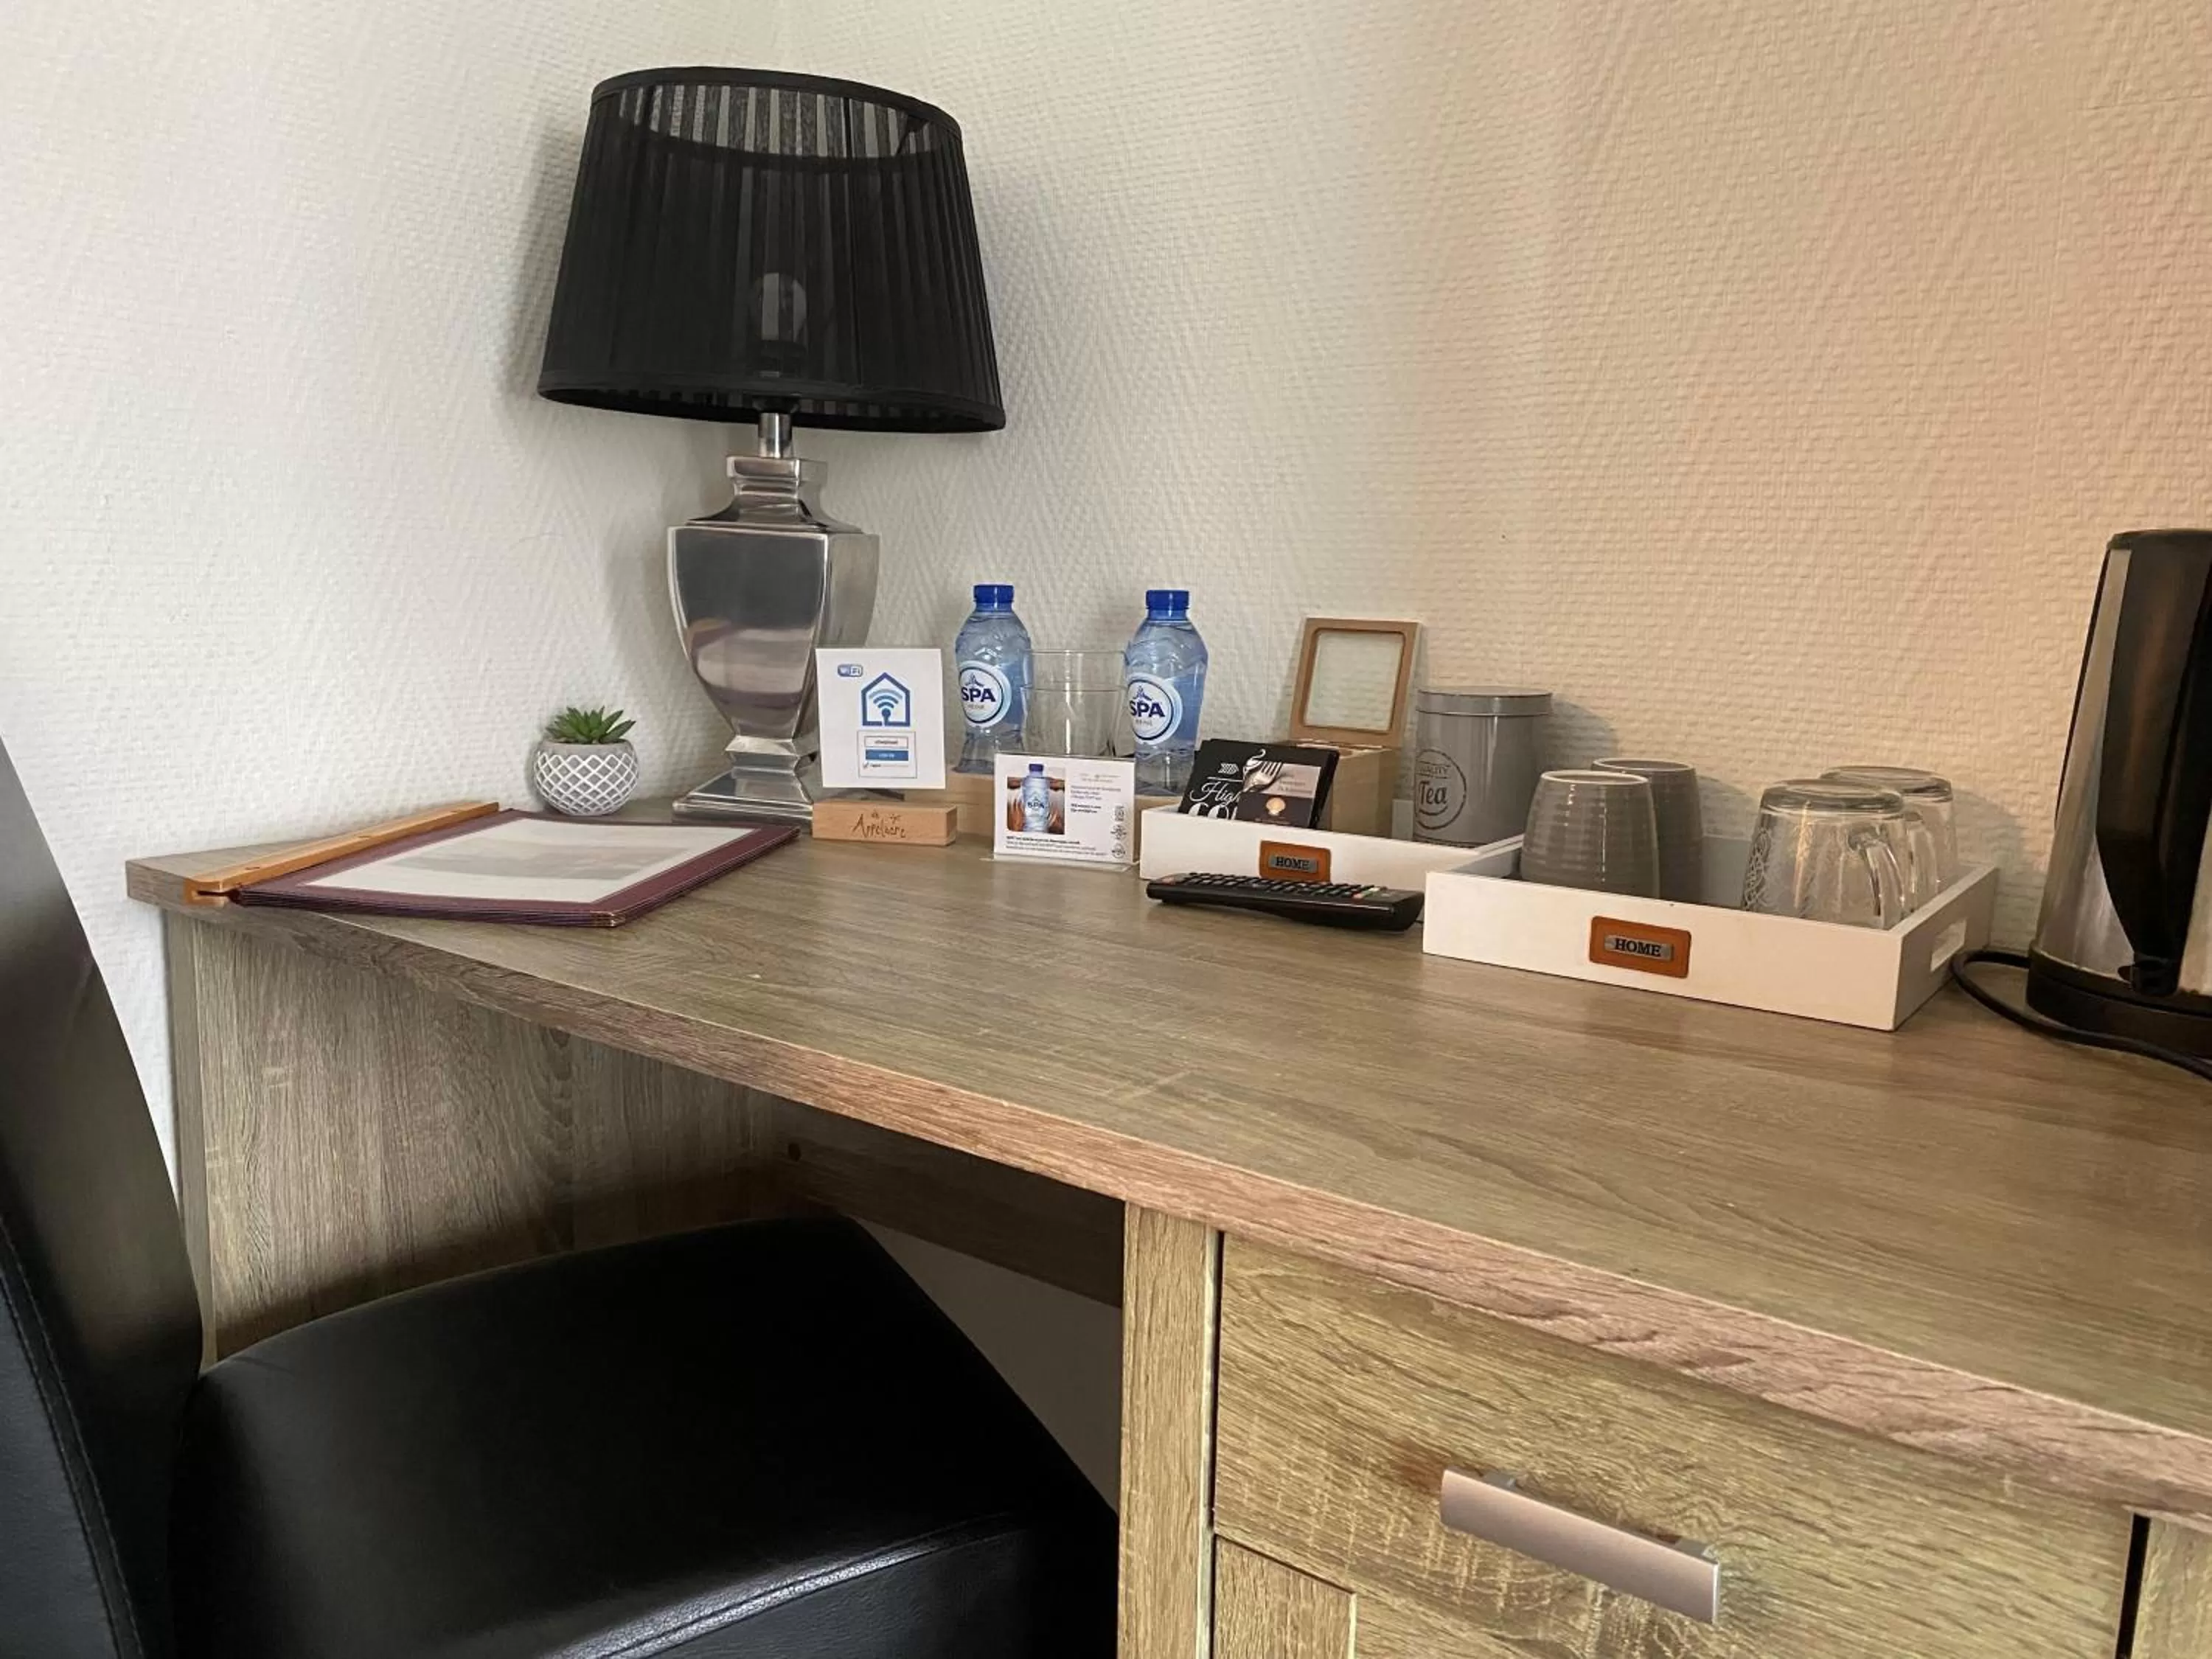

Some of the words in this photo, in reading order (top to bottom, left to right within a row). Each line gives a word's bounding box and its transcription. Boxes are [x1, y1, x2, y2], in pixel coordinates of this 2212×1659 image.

[961, 686, 996, 702] SPA
[1129, 700, 1165, 717] SPA
[1418, 780, 1447, 805] Tea
[1027, 801, 1045, 809] SPA
[1275, 856, 1310, 870] HOME
[1615, 937, 1662, 958] HOME
